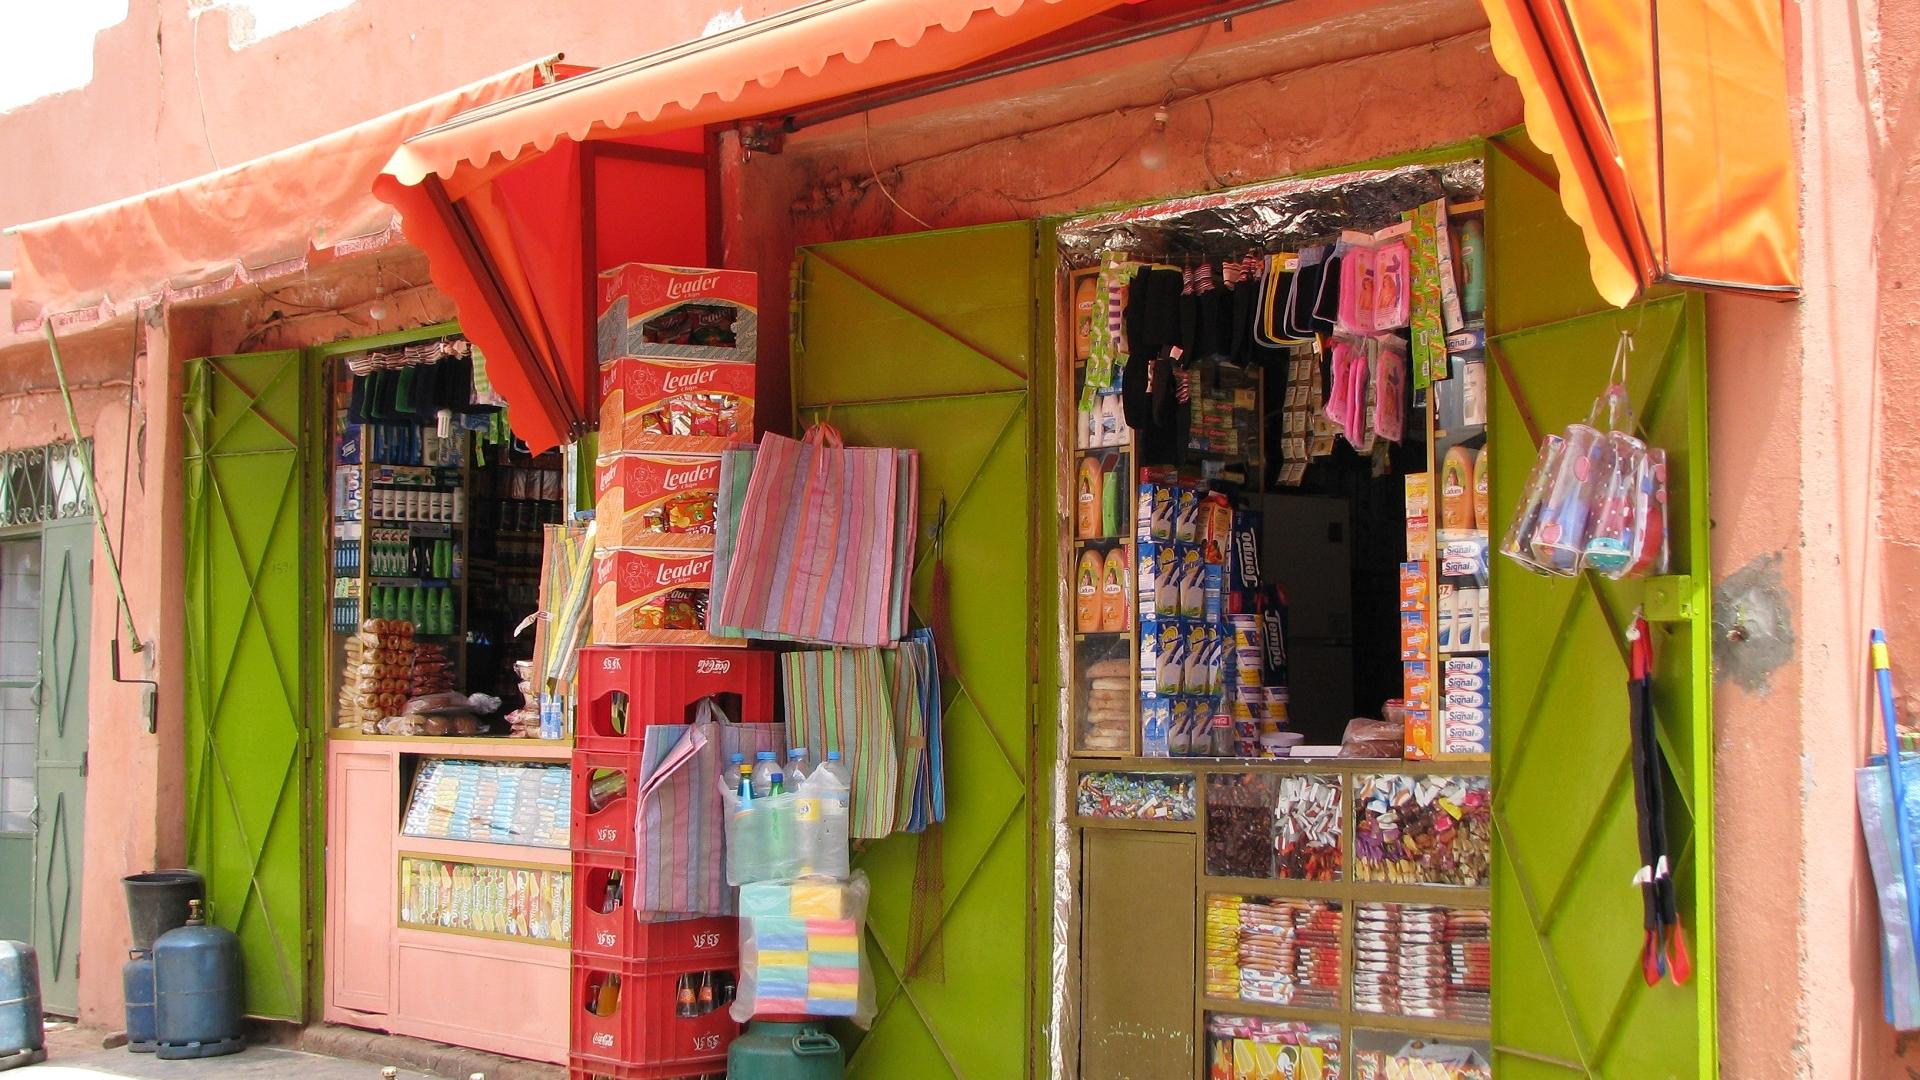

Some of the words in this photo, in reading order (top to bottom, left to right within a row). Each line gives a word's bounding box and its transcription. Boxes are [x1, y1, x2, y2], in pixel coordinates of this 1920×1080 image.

[666, 276, 720, 299] Leader
[1448, 338, 1467, 347] ignal
[662, 368, 718, 393] Leader
[663, 465, 717, 491] Leader
[1447, 545, 1472, 555] Signal
[1445, 562, 1471, 571] Signal
[656, 559, 711, 585] Leader
[696, 659, 730, 674] Coca-Cola
[1449, 661, 1473, 670] Signal
[1448, 678, 1473, 687] Signal
[1449, 695, 1474, 704] Signal
[1449, 711, 1474, 721] Signal
[1449, 728, 1474, 737] Signal
